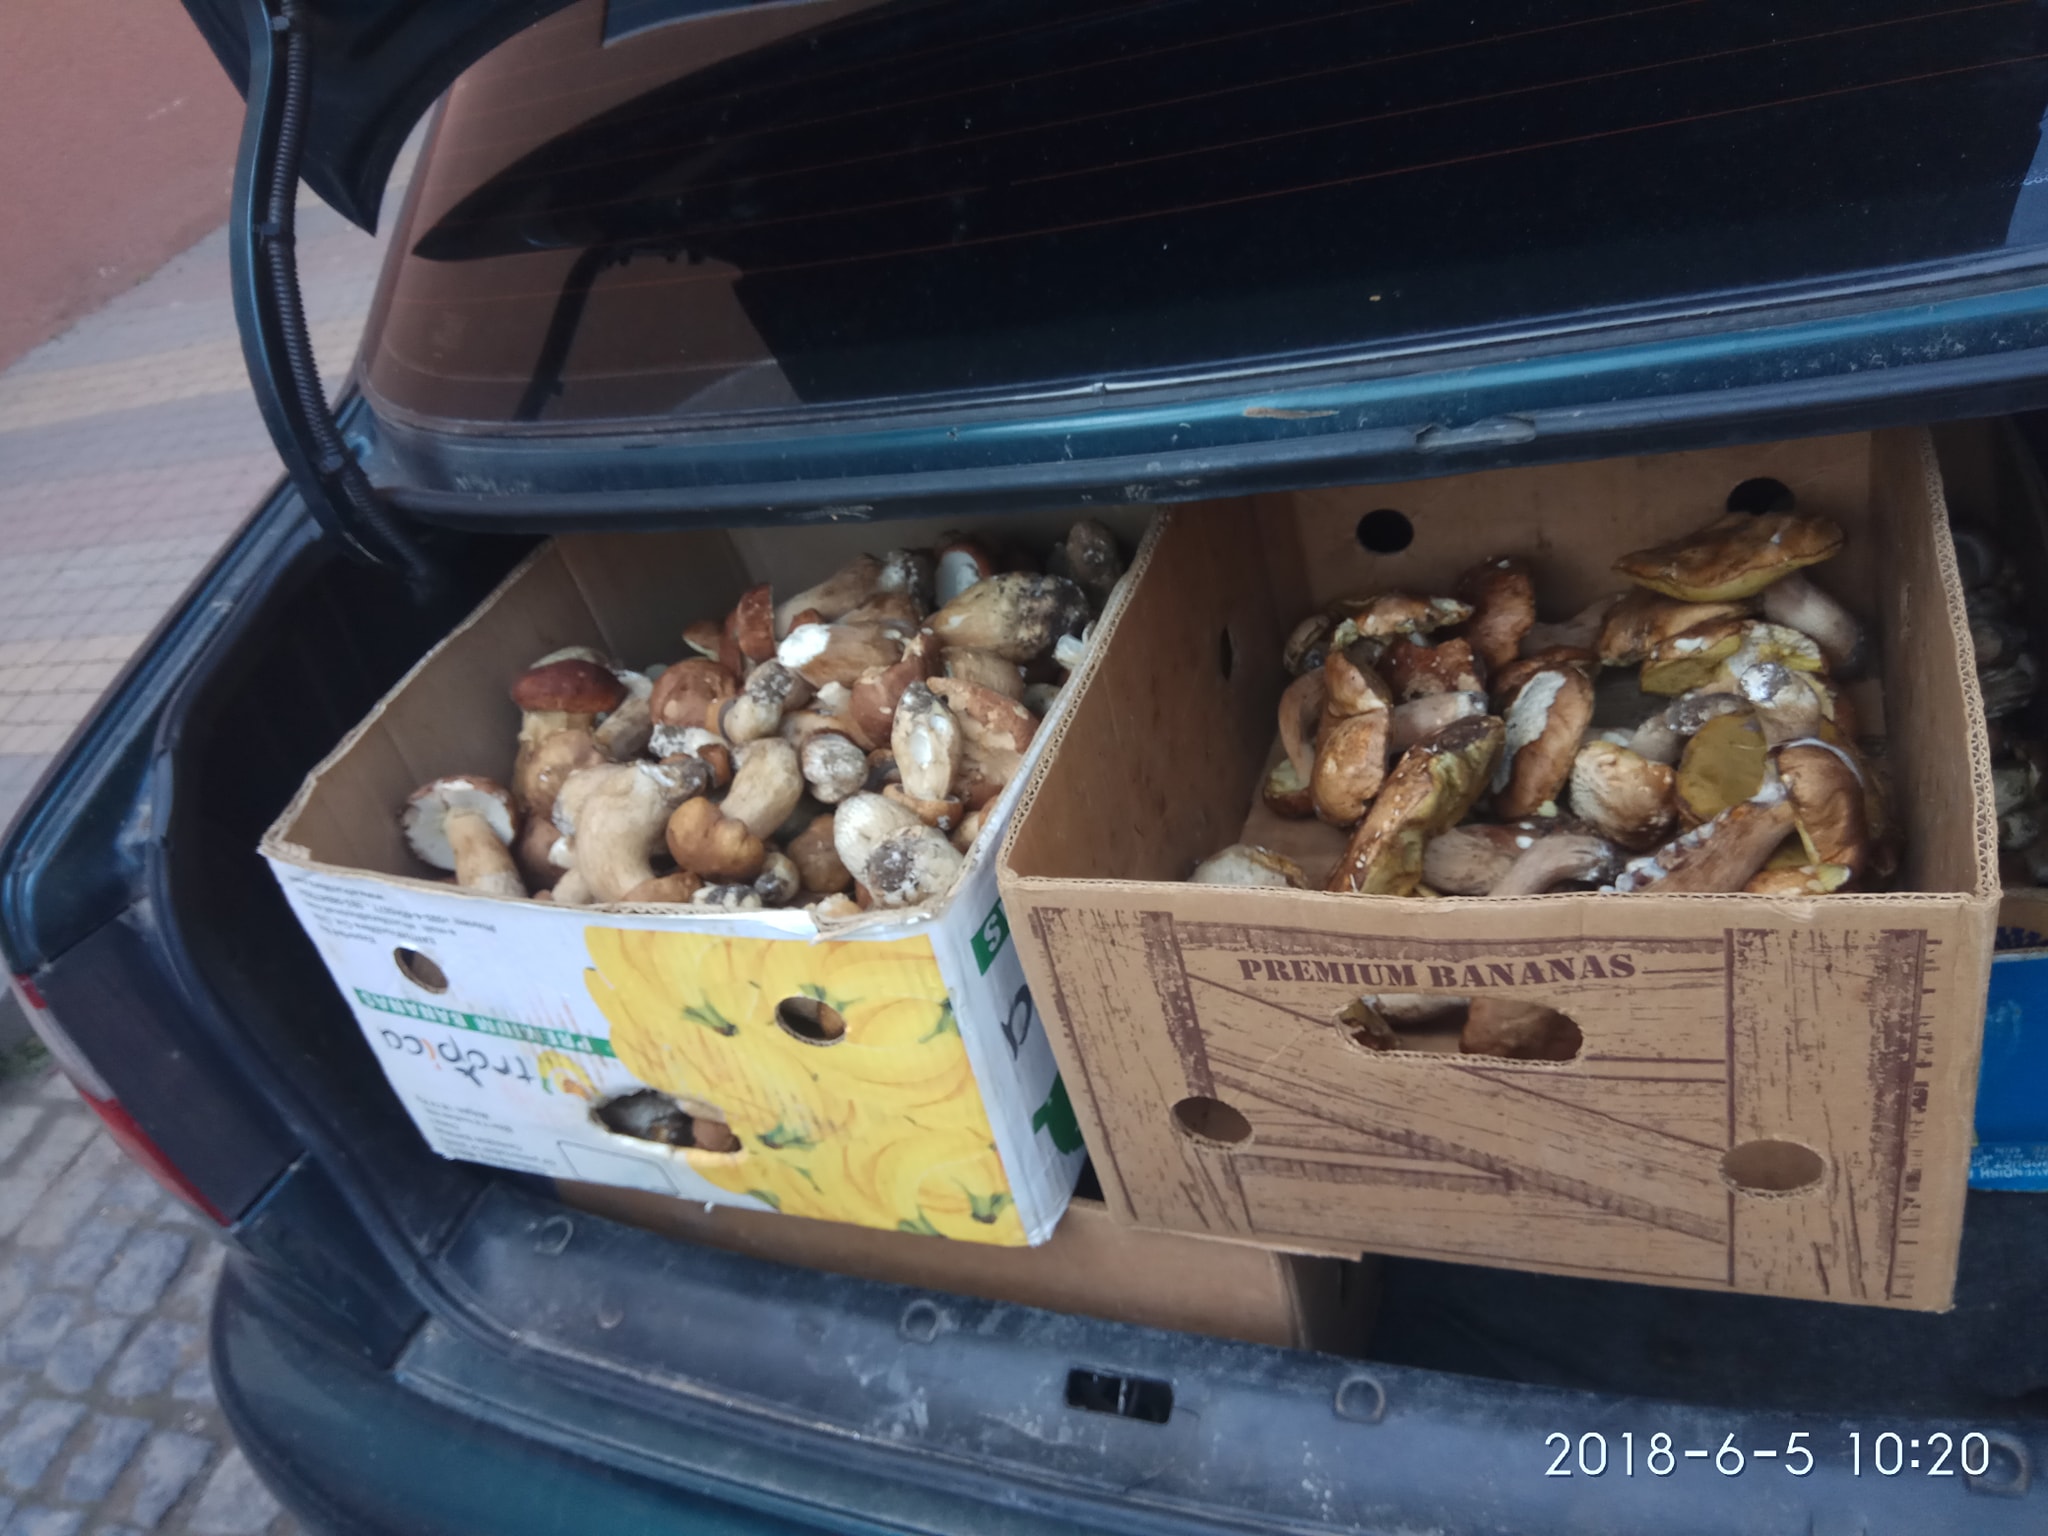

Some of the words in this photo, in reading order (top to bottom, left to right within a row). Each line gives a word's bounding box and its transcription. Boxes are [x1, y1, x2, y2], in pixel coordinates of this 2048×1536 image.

[1237, 958, 1418, 988] PREMIUM
[1427, 953, 1636, 988] BANANAS
[359, 990, 468, 1028] BANANAS
